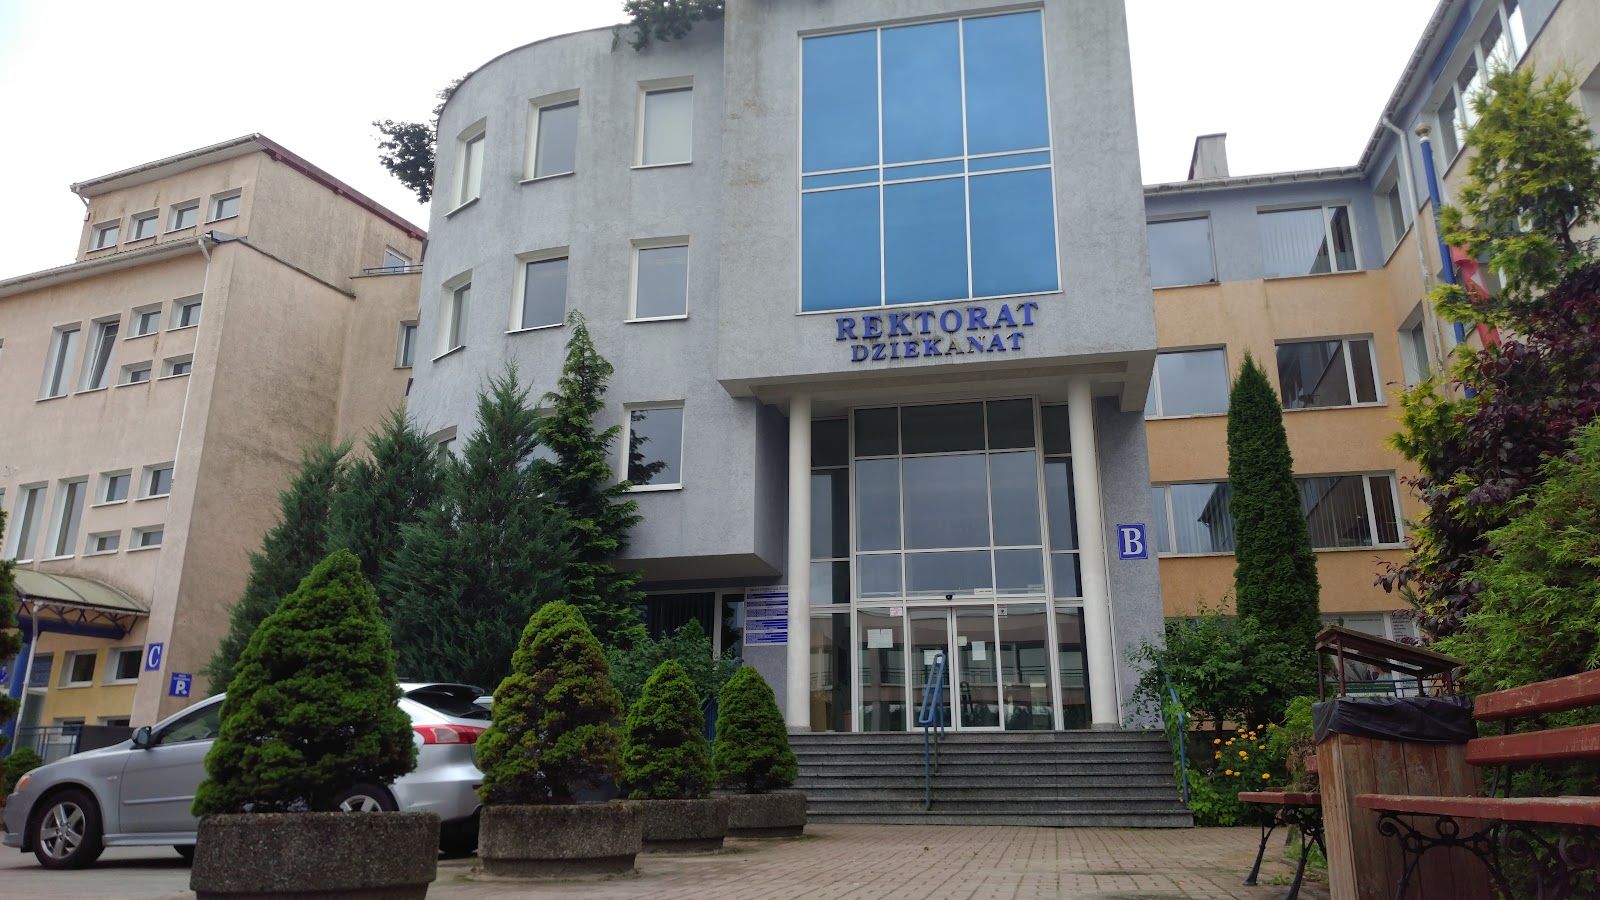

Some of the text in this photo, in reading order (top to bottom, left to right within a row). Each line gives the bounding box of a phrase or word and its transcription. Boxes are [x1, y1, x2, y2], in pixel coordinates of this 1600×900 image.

[836, 302, 1038, 341] REKTORAT
[851, 332, 1024, 362] DZIEKANAT
[1121, 527, 1143, 555] B
[148, 645, 160, 668] C
